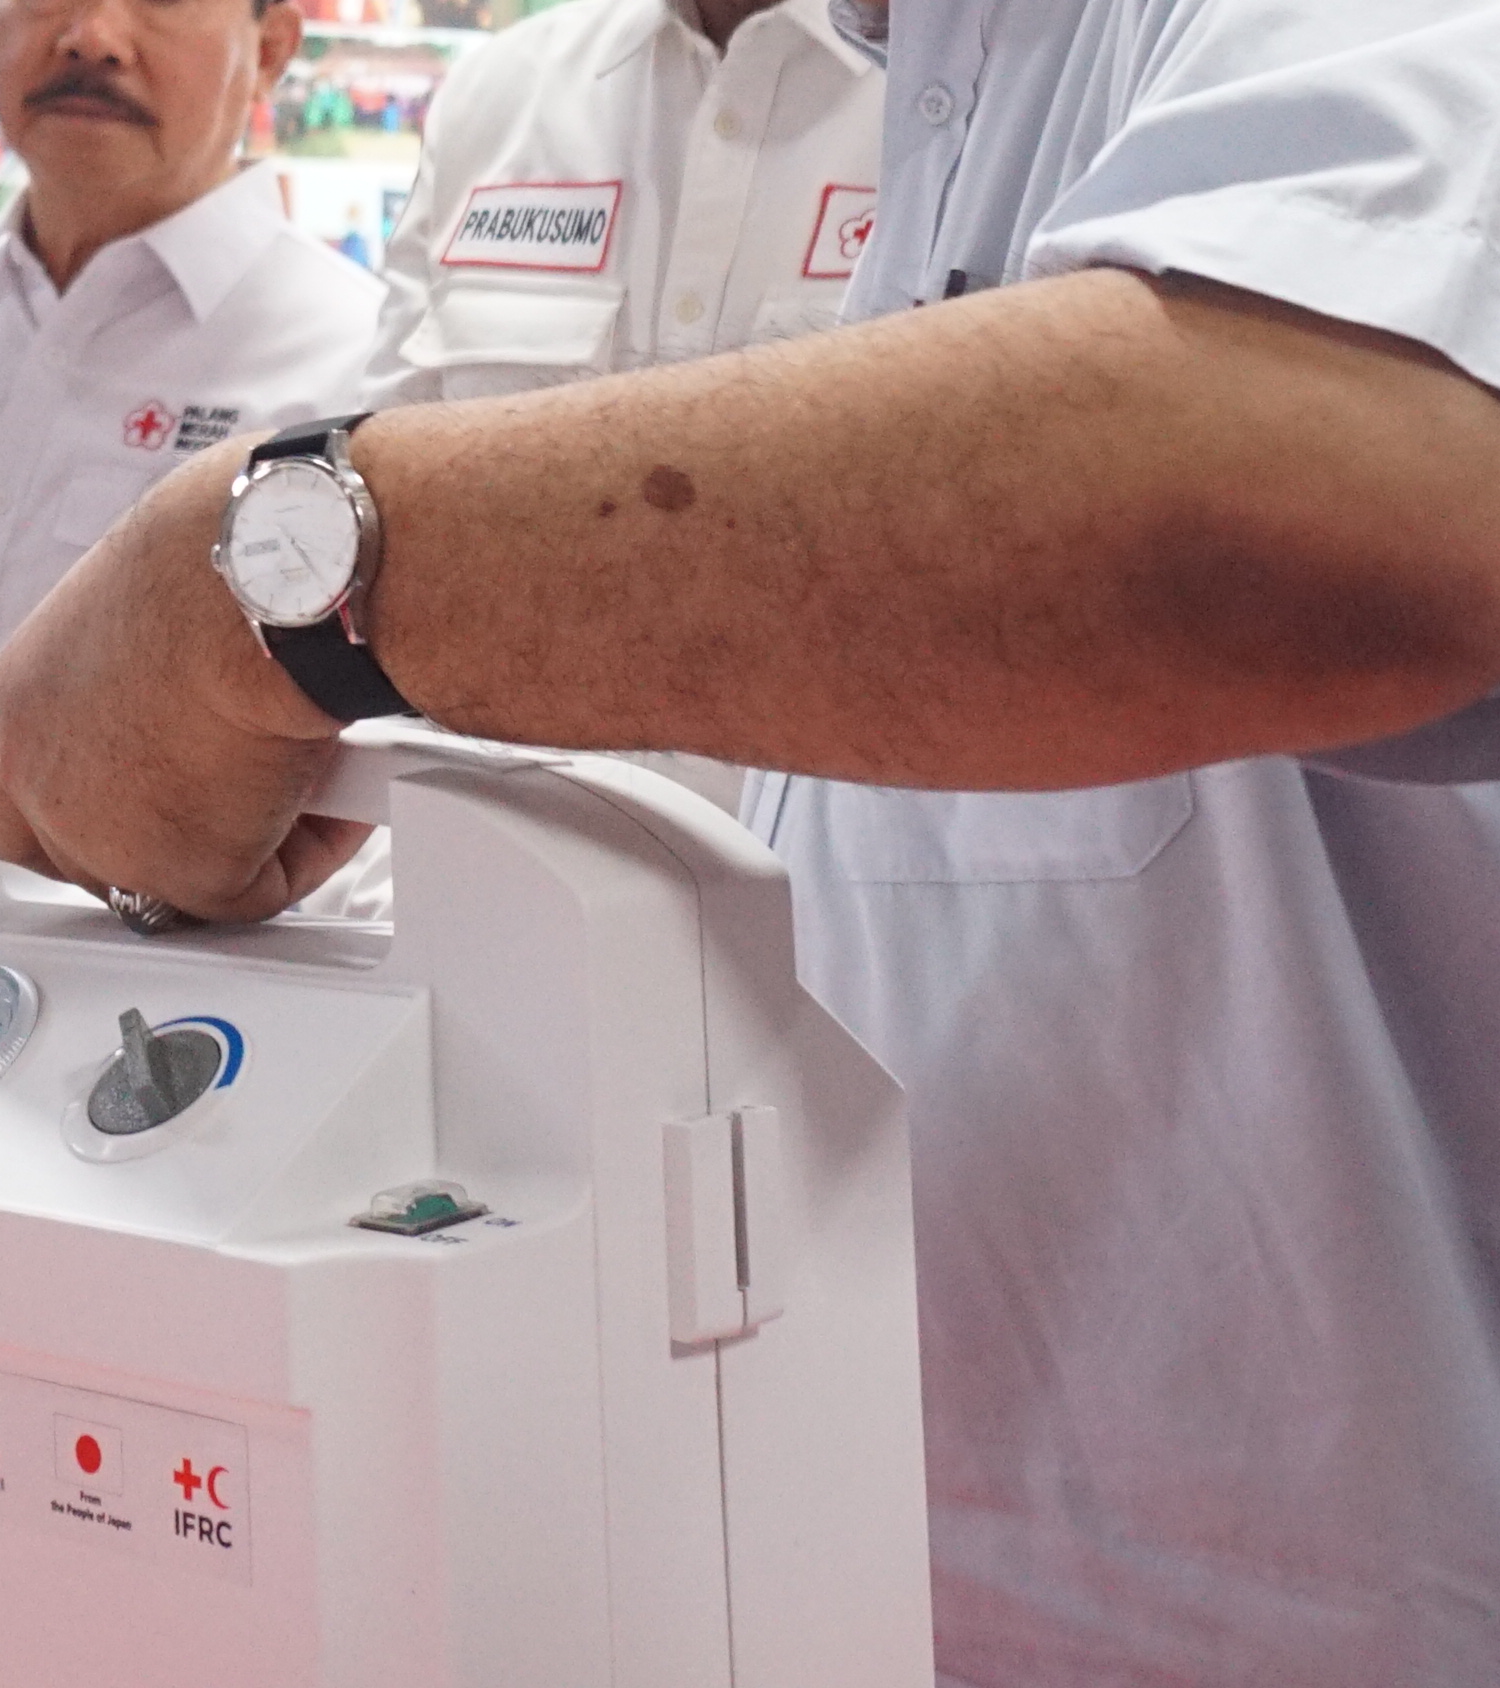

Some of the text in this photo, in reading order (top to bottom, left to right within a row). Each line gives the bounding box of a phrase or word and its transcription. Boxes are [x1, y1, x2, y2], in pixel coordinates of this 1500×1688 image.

[458, 206, 607, 245] PRABUKUSUMO
[50, 1499, 132, 1531] the People of Japan
[79, 1490, 102, 1506] From
[174, 1507, 233, 1549] IFRC
